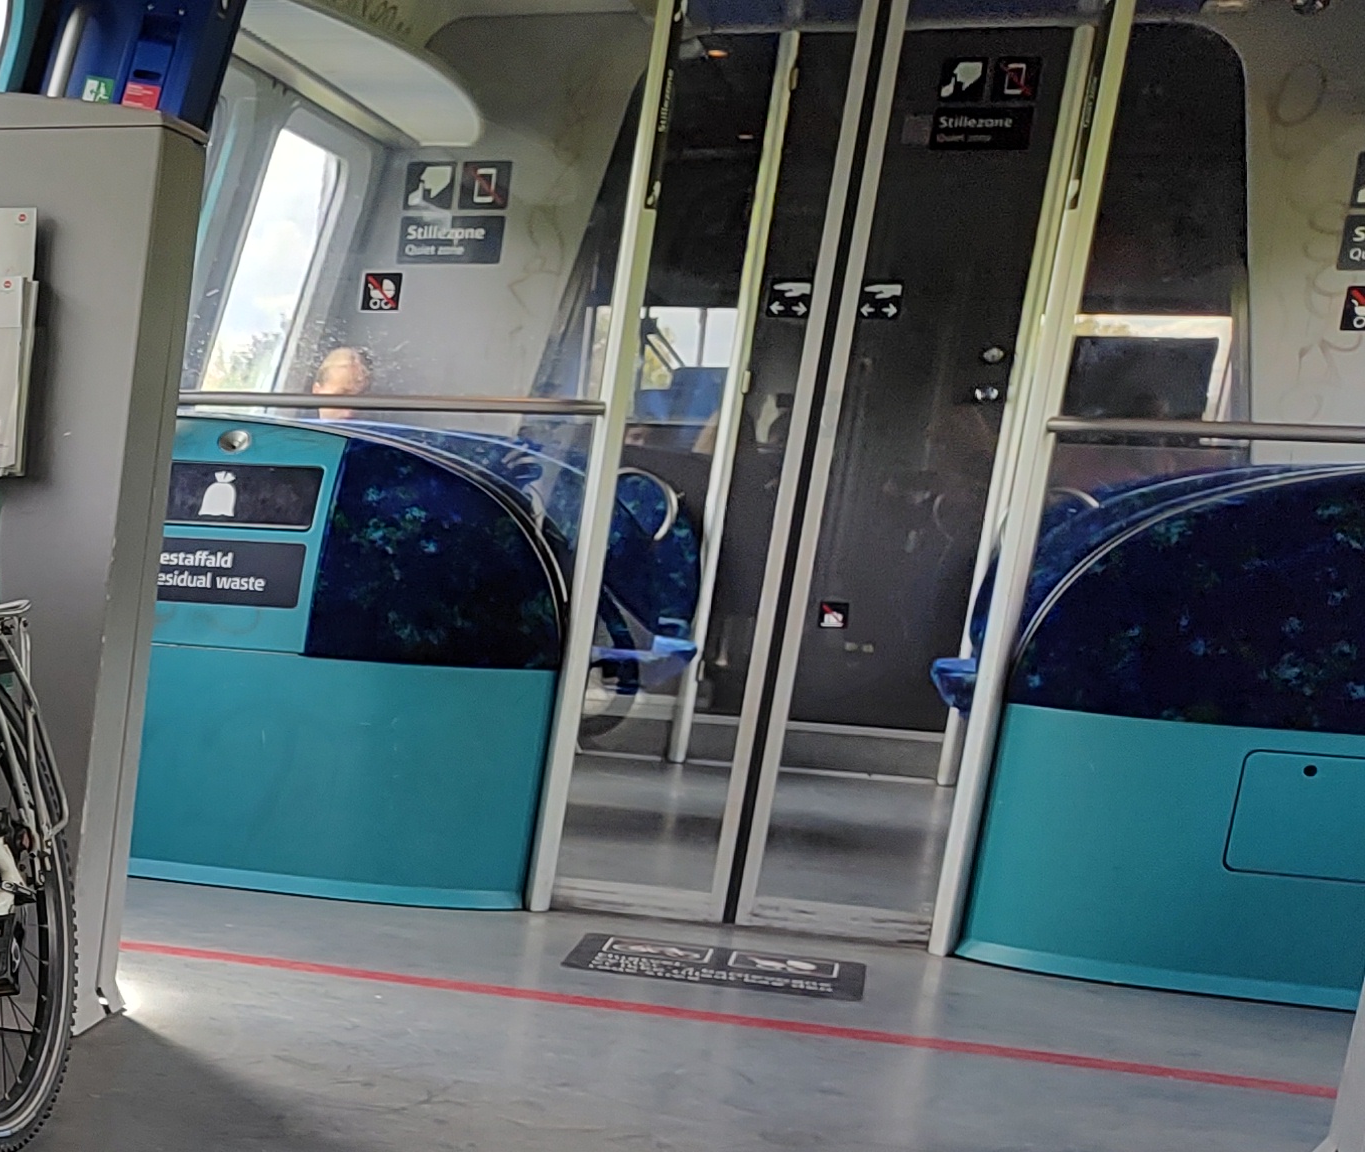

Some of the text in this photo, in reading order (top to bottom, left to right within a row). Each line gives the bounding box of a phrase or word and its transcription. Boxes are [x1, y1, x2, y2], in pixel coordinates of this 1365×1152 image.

[939, 115, 1013, 129] Stillezone
[406, 225, 486, 240] Stillezone
[159, 551, 234, 568] estaffald
[157, 570, 266, 592] esidual waste
